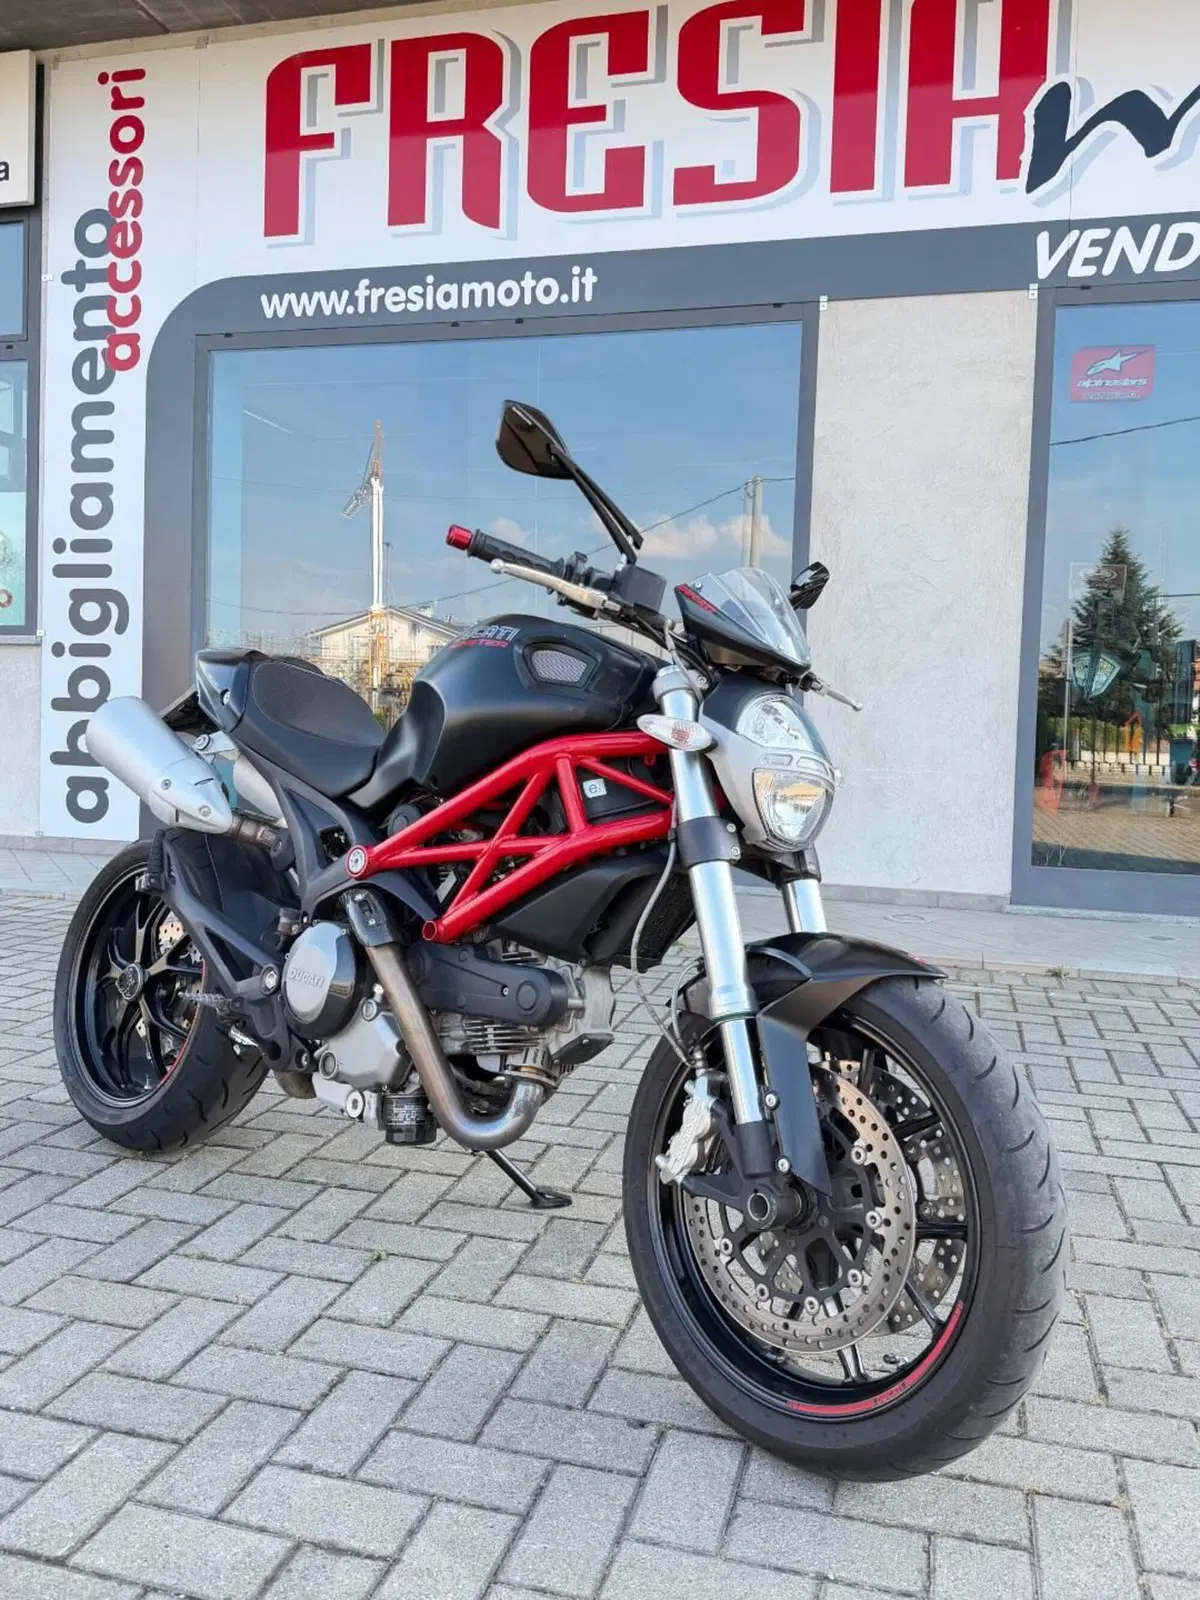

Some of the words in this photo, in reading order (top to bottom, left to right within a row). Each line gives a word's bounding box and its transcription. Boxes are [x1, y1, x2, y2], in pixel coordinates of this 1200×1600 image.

[98, 69, 146, 371] accessori
[264, 0, 1050, 237] FRESIA
[260, 265, 598, 319] www.fresiamoto.it
[50, 208, 129, 824] abbigliamento
